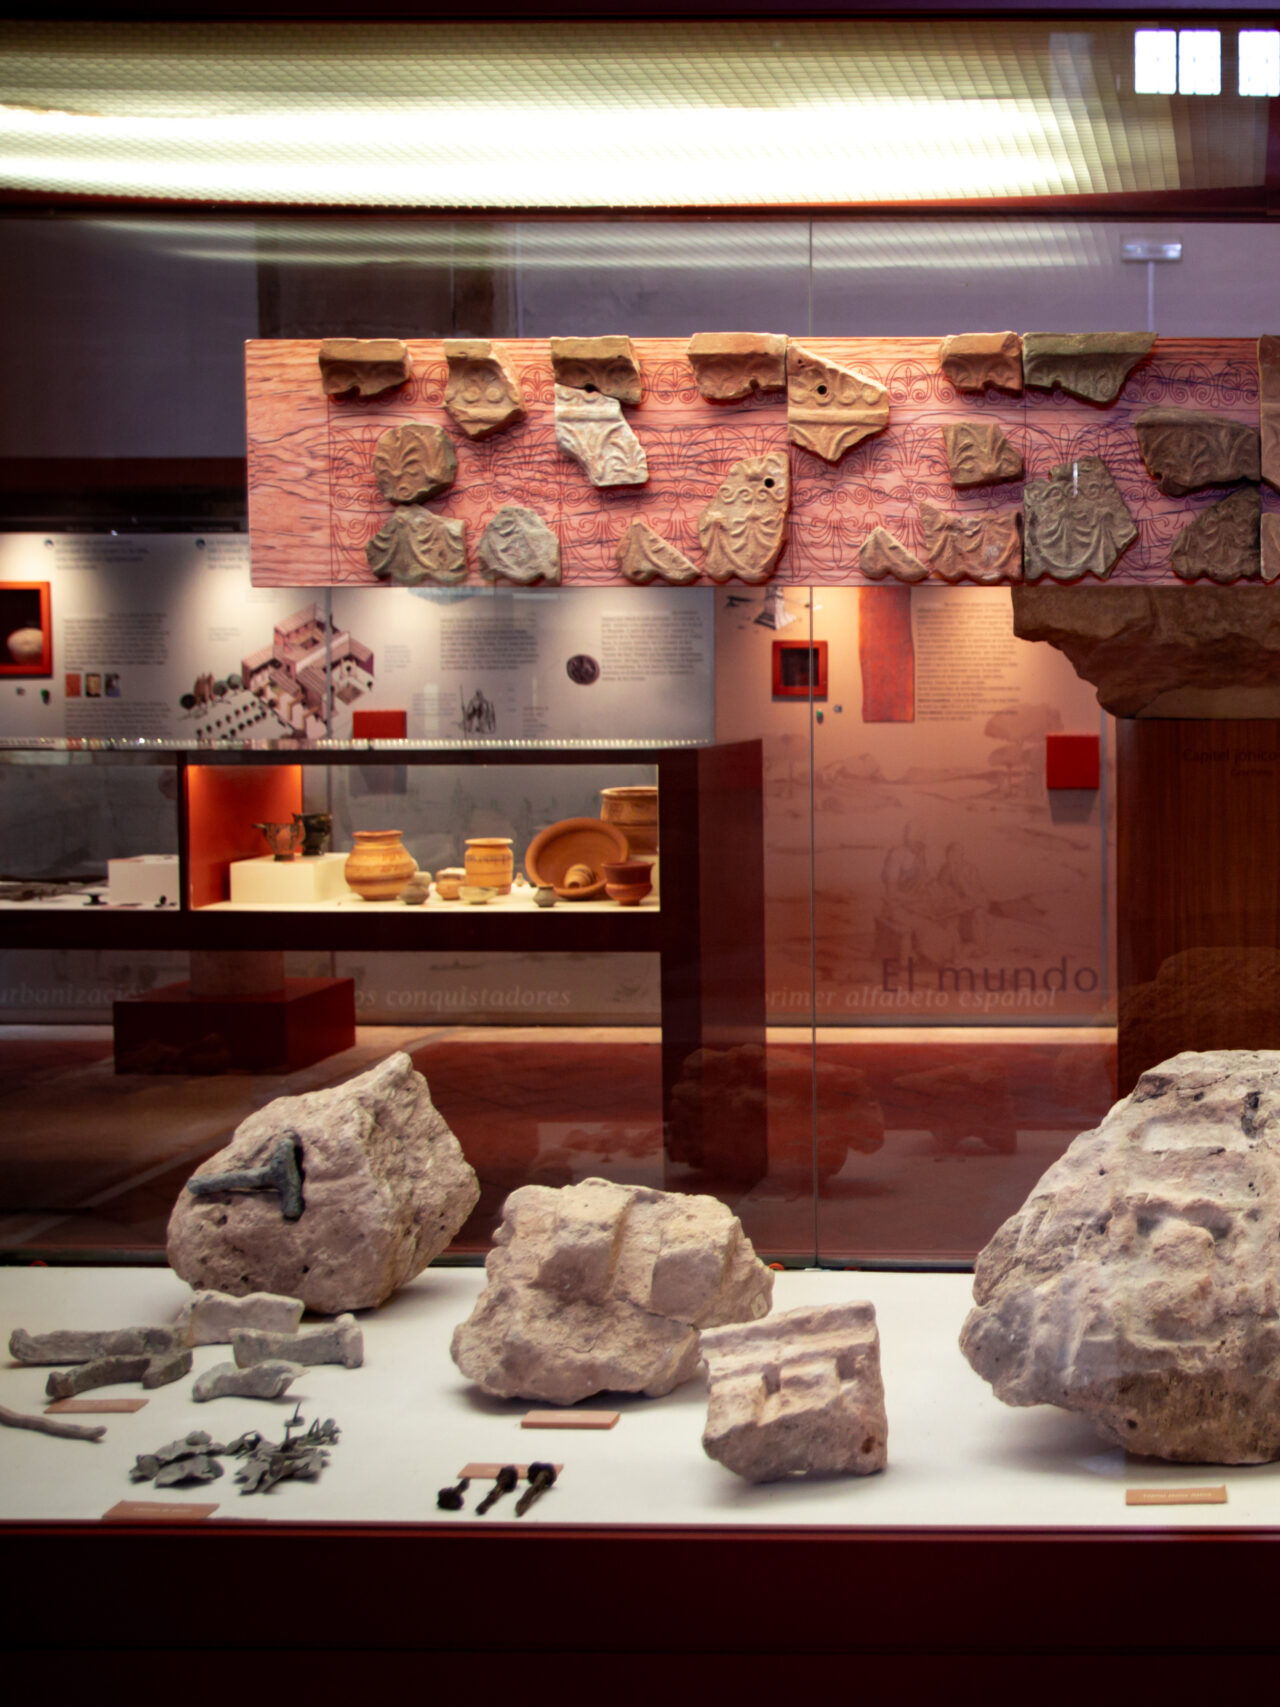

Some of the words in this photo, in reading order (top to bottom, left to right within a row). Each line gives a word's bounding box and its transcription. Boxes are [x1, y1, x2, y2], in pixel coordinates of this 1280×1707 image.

[881, 956, 914, 993] El
[937, 956, 1099, 993] mundo
[385, 985, 571, 1011] conquistadores
[765, 986, 837, 1008] rimer
[845, 985, 950, 1008] alfabeto
[958, 985, 1057, 1013] español
